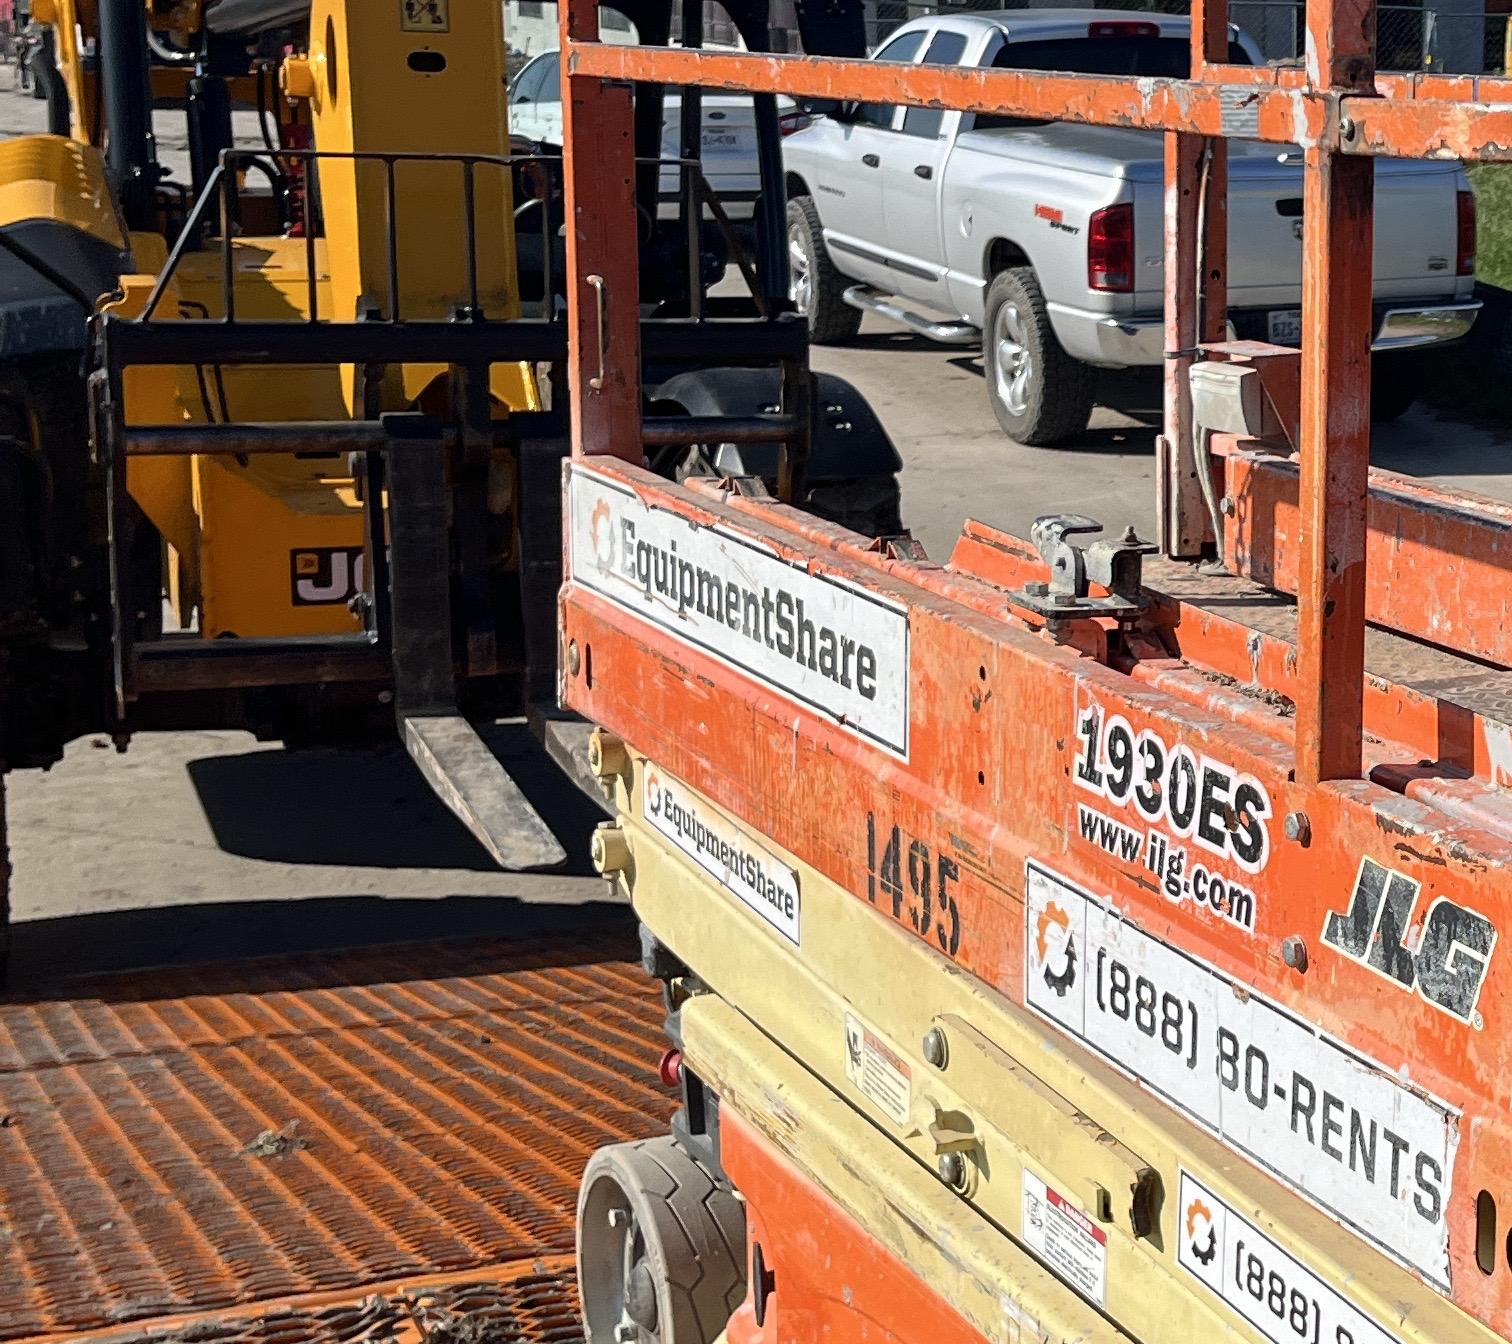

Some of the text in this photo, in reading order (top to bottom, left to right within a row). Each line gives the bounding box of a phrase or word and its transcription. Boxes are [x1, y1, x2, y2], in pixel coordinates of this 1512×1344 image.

[620, 515, 878, 702] EquipmentShare
[664, 787, 795, 921] EquipmentShare
[1077, 706, 1268, 865] 1930ES
[866, 810, 961, 957] 1495
[1319, 854, 1499, 1028] JLG
[1096, 945, 1443, 1225] (888) 80-RENTS
